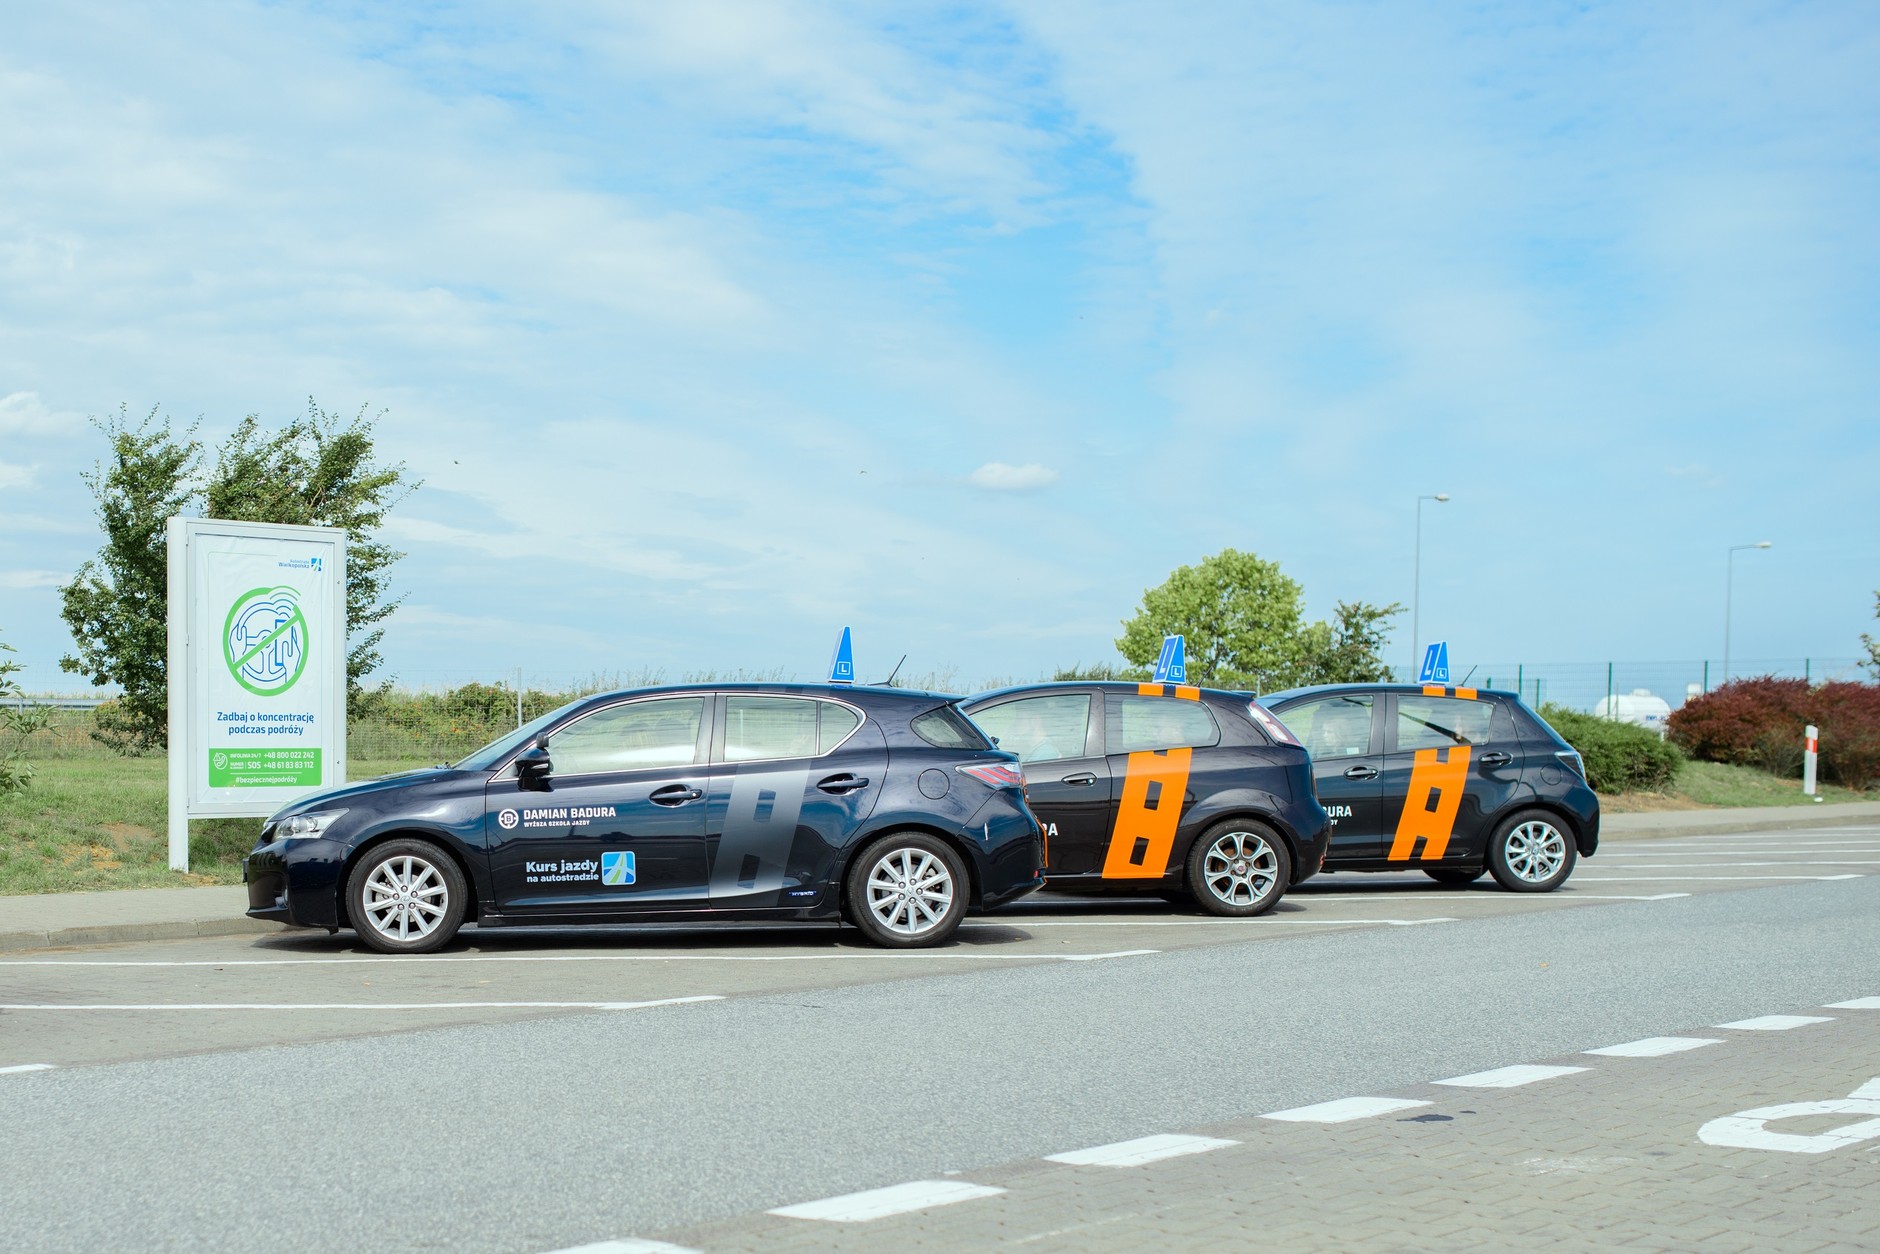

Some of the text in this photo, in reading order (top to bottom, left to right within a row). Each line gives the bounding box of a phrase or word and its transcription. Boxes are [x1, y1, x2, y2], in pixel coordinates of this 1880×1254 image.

[217, 711, 314, 724] Zadbaj o koncentrację
[228, 724, 304, 736] podczas podróży
[290, 751, 302, 759] 022
[247, 761, 261, 769] SOS
[264, 761, 276, 769] +48
[277, 761, 285, 769] 61
[285, 761, 294, 769] 83
[294, 761, 303, 769] 83
[236, 776, 297, 784] #bezpiecznejpodróży
[523, 807, 617, 820] DAMIAN BADURA
[524, 820, 547, 828] WYŻSZA
[525, 859, 599, 874] Kurs jazdy
[526, 872, 599, 883] na autostradzie
